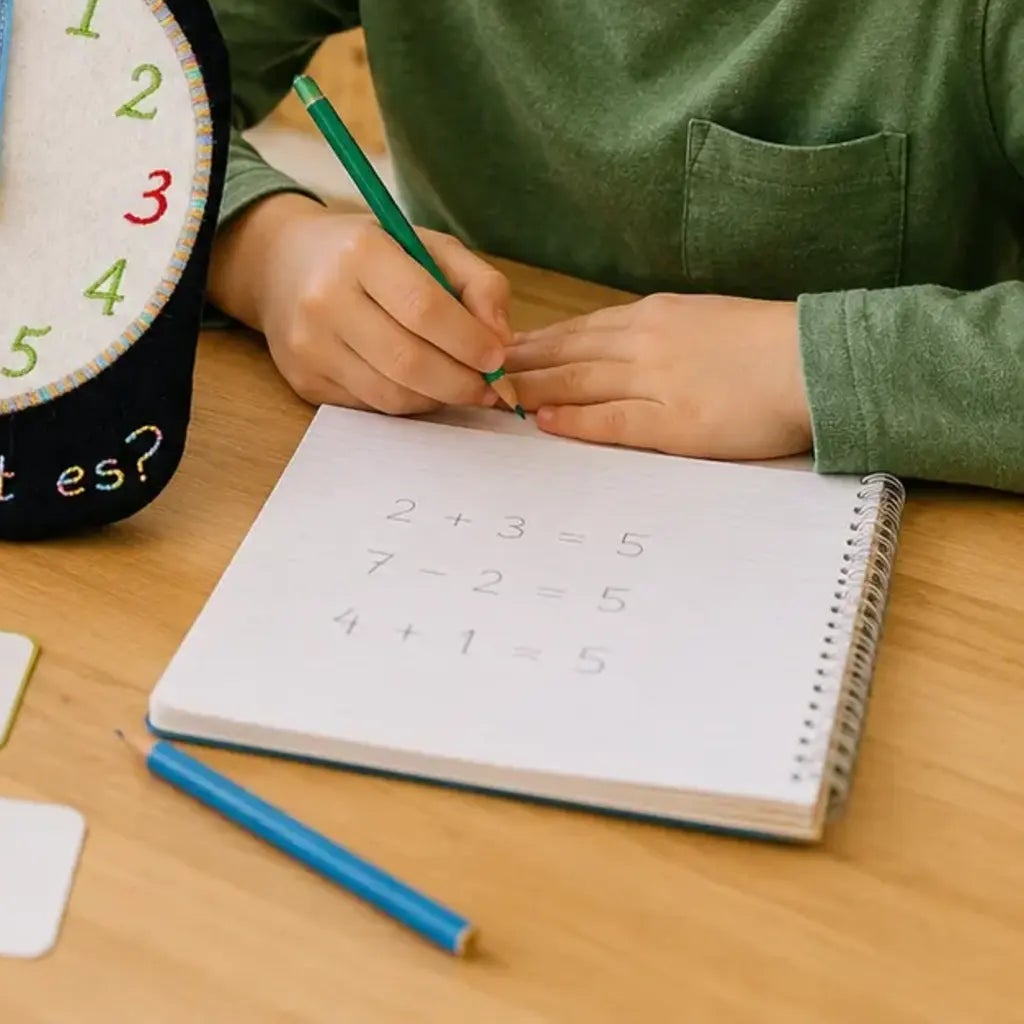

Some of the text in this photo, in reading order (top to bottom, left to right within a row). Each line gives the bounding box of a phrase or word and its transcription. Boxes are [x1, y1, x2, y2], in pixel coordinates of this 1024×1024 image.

[116, 64, 162, 119] 2
[123, 169, 172, 226] 3
[85, 259, 126, 316] 4
[1, 326, 51, 378] 5
[56, 425, 163, 498] es?
[386, 498, 651, 558] 2 + 3 = 5
[367, 548, 396, 576] 7
[472, 569, 504, 596] 2
[597, 586, 632, 614] 5
[331, 607, 359, 637] 4
[459, 629, 477, 656] 1
[574, 645, 613, 676] 5
